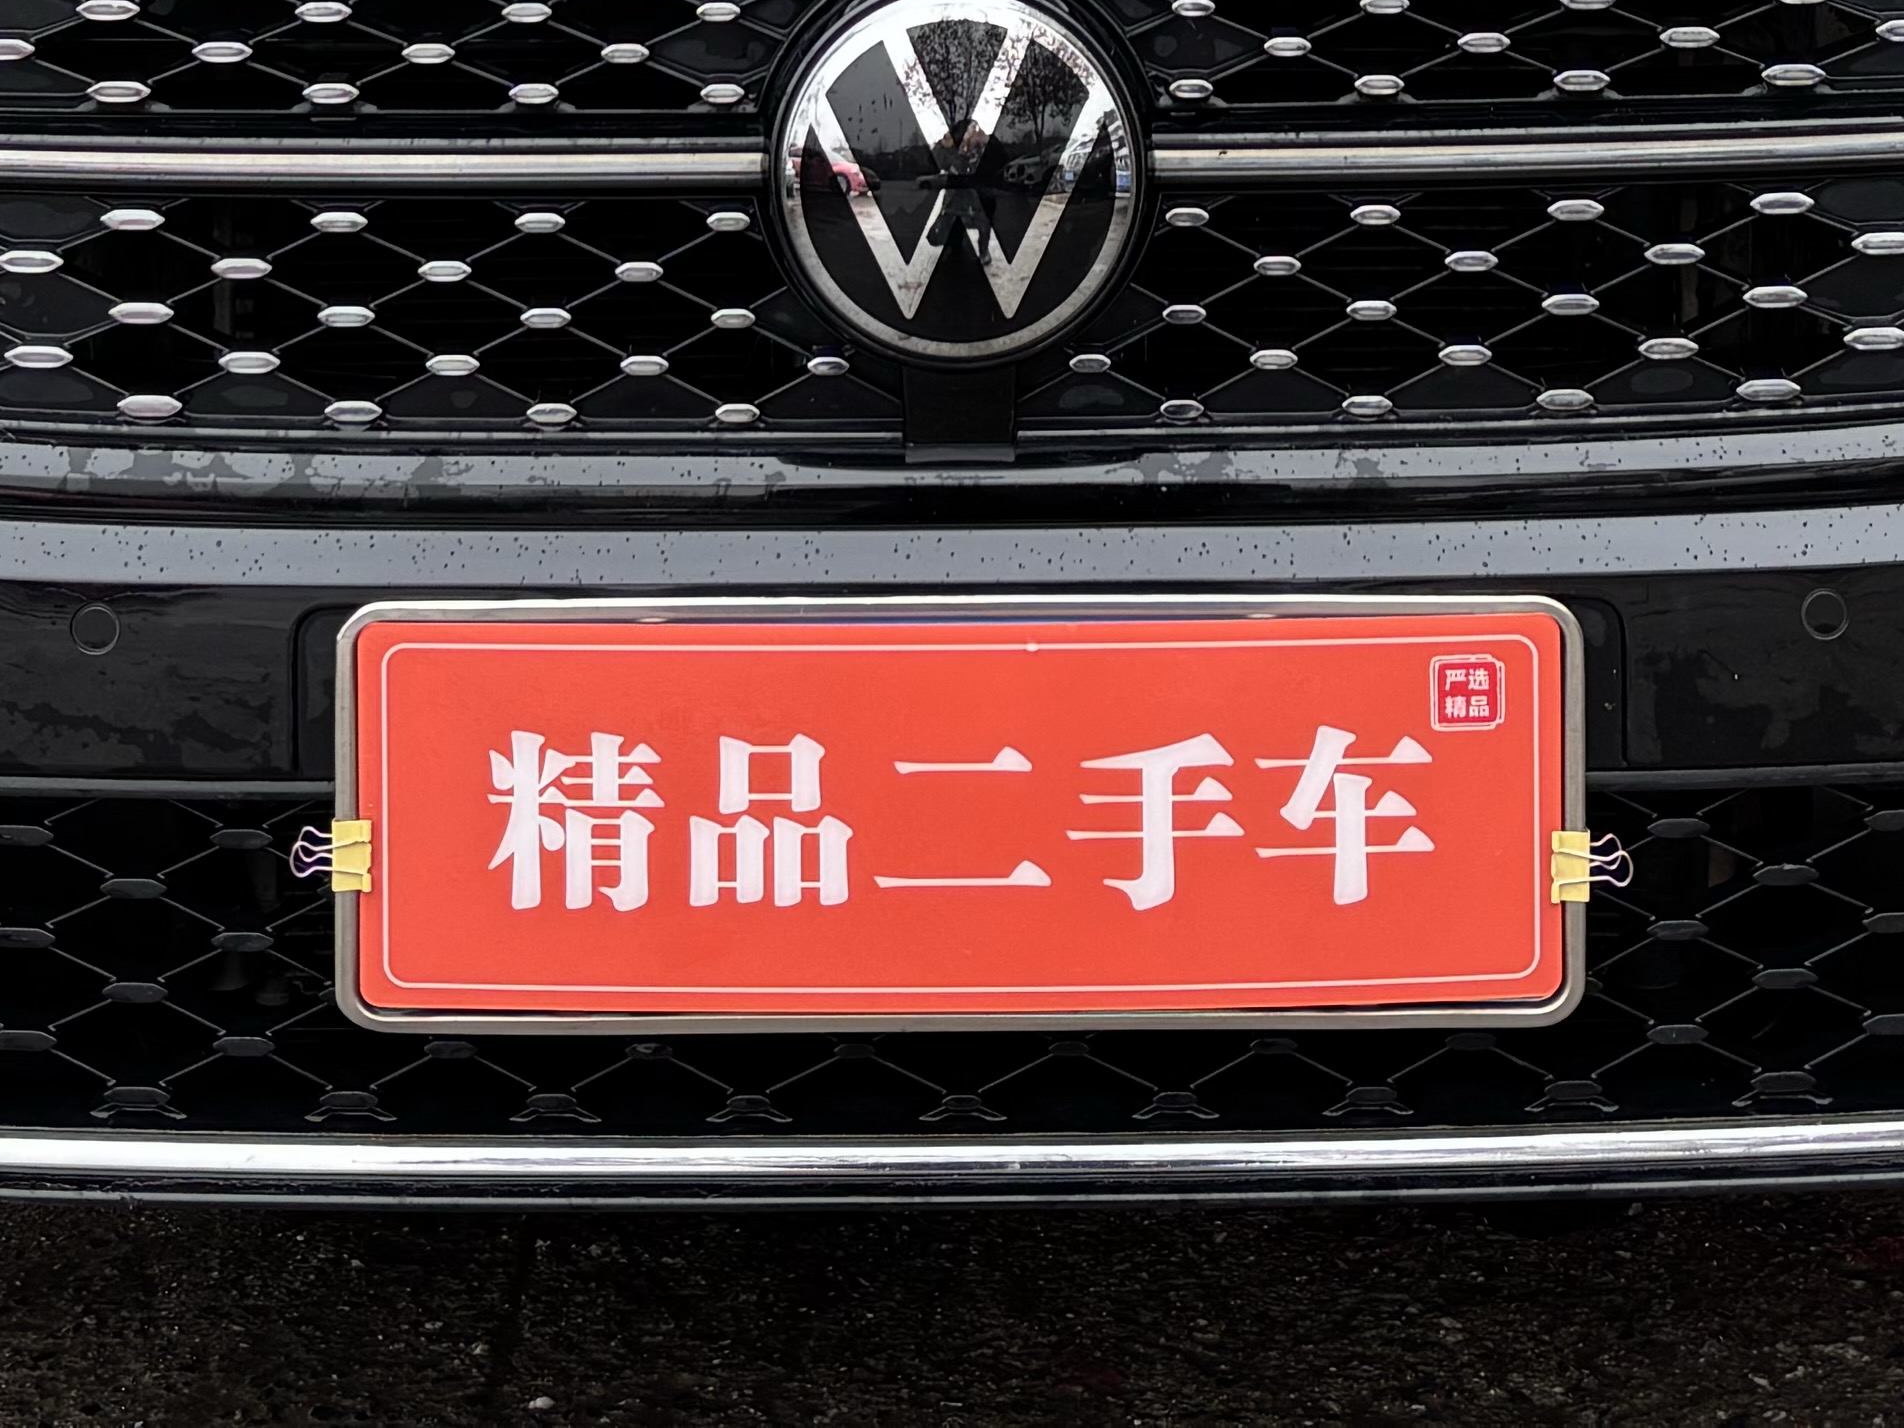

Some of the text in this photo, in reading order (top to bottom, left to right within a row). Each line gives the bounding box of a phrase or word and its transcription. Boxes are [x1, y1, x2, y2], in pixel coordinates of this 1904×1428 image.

[1444, 666, 1490, 692] 严选
[1444, 695, 1490, 719] 精品
[486, 724, 1435, 913] 精品二手车
